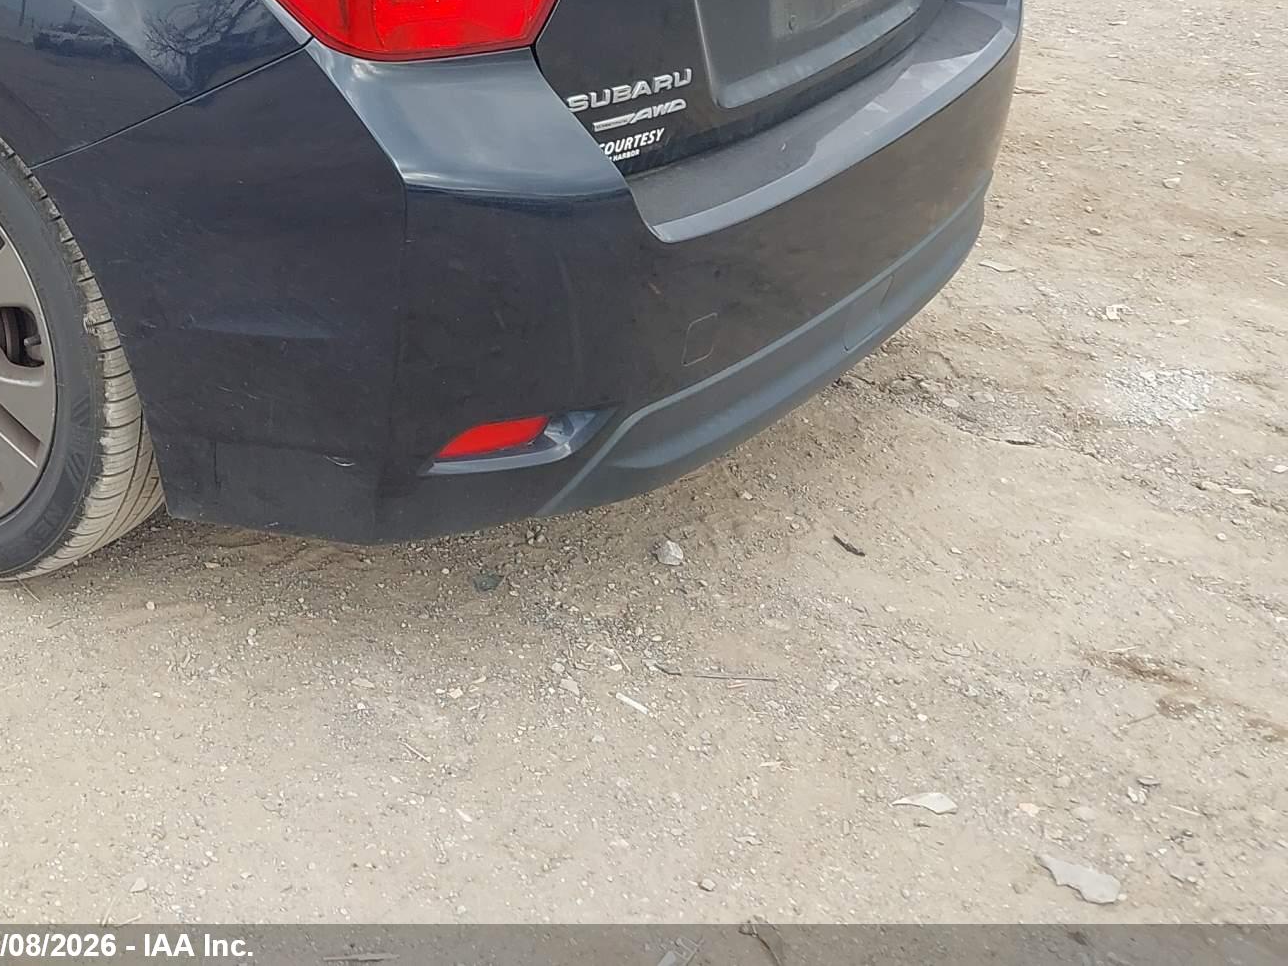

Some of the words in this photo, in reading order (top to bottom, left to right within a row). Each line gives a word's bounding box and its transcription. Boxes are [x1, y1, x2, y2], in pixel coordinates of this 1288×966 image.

[566, 68, 692, 113] SUBARU
[630, 98, 687, 124] AWD
[612, 149, 640, 161] HARBOR
